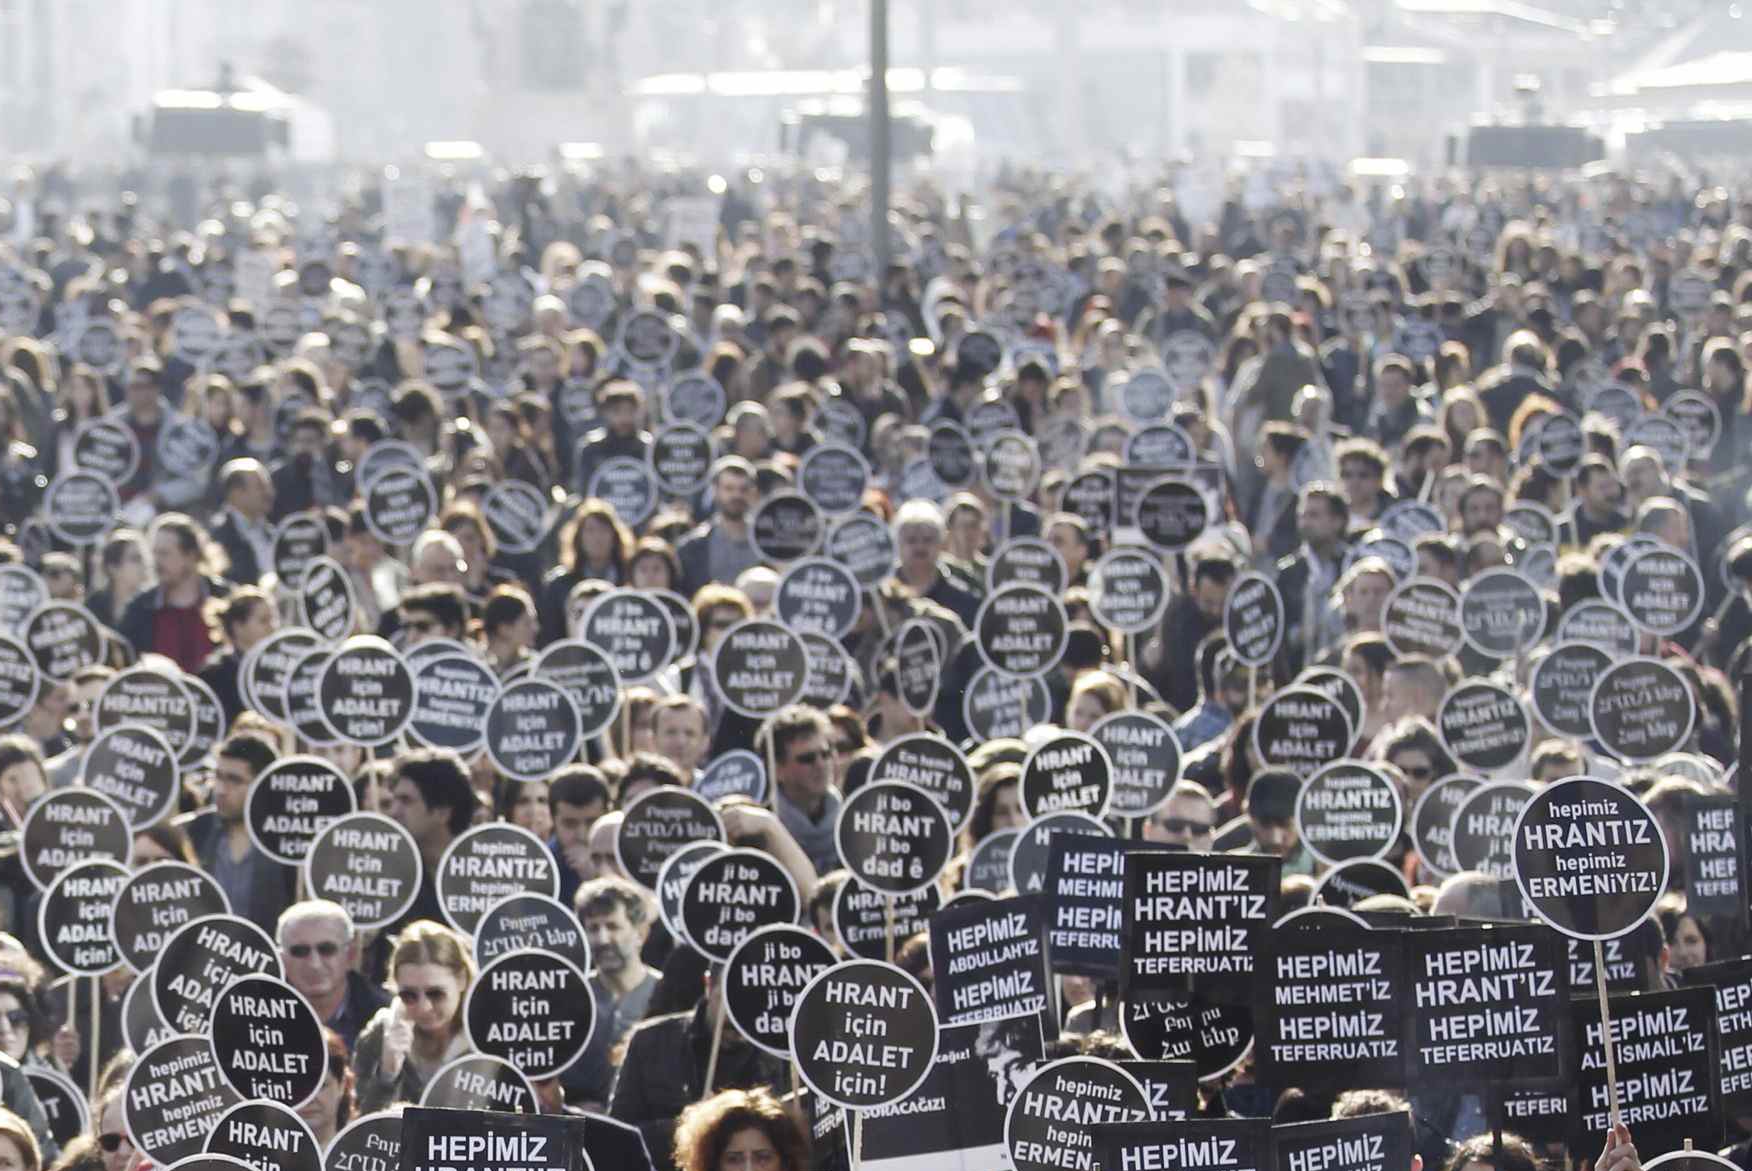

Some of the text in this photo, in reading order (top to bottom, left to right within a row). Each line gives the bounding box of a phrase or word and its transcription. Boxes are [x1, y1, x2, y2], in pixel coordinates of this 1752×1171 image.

[1549, 799, 1619, 820] hepimiz
[853, 813, 935, 837] HRANT
[1524, 819, 1651, 850] HRANTIZ
[333, 829, 402, 851] HRANT
[348, 853, 382, 873] için
[862, 855, 903, 877] dad
[1556, 851, 1626, 873] hepimiz
[324, 874, 402, 897] ADALET
[492, 969, 570, 990] HRANT
[826, 981, 914, 1009] HRANT
[512, 996, 549, 1018] için
[487, 1021, 575, 1042] ADALET
[845, 1012, 886, 1037] için
[507, 1045, 555, 1070] için!
[813, 1040, 913, 1068] ADALET
[1271, 1040, 1398, 1061] TEFERRUATIZ
[1420, 1036, 1554, 1064] TEFERRUATIZ
[835, 1070, 886, 1096] için!
